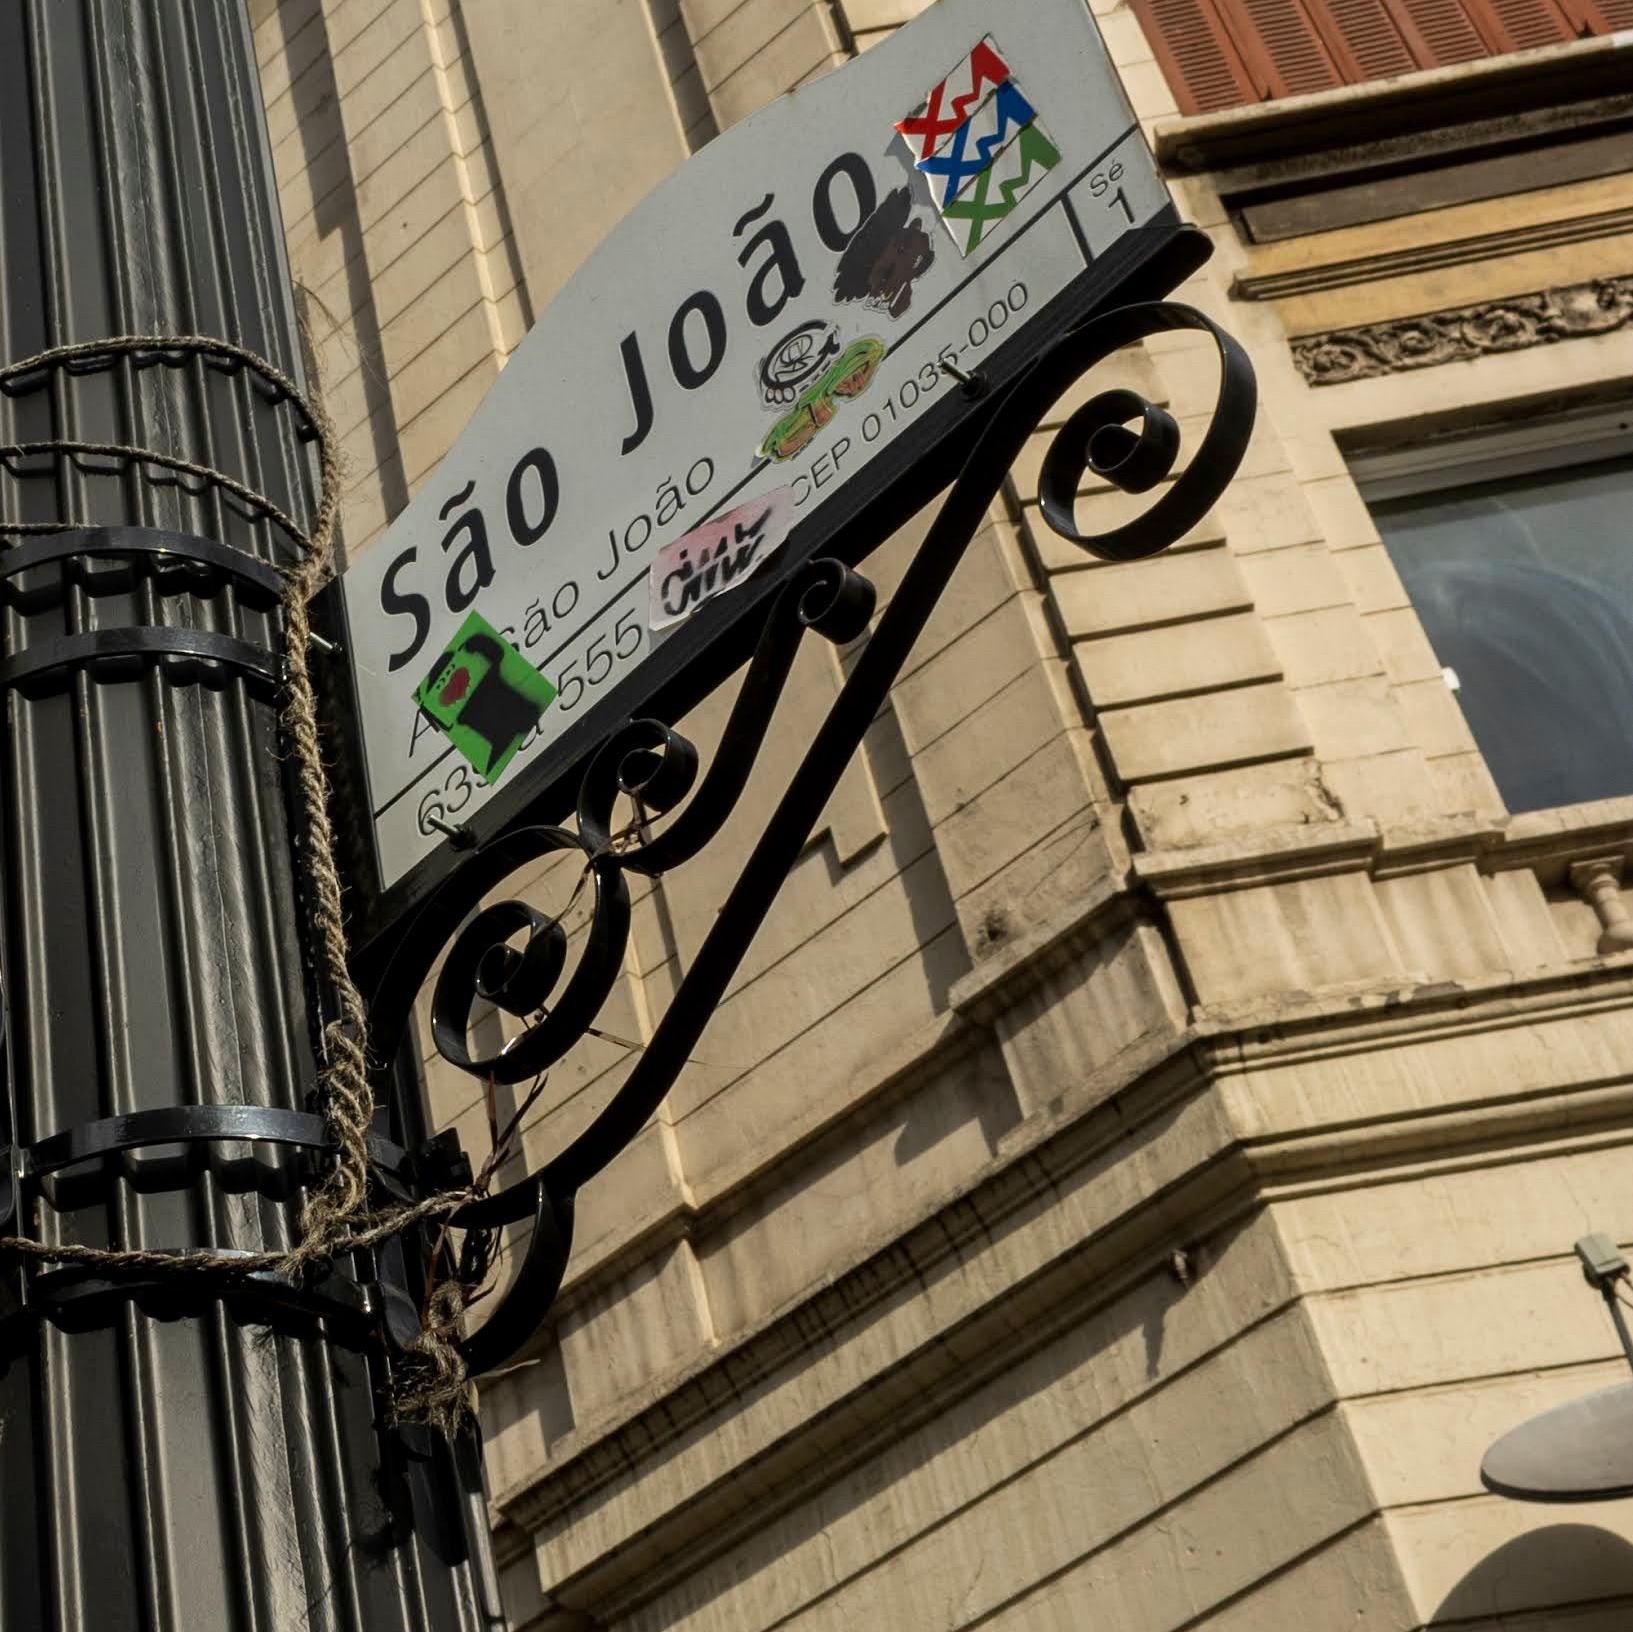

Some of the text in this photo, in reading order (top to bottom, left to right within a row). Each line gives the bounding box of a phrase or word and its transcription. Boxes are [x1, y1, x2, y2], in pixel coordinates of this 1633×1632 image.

[1089, 159, 1125, 199] Sé
[1107, 186, 1136, 225] 1
[379, 443, 561, 673] São
[619, 150, 878, 457] João
[555, 607, 644, 712] 555
[860, 281, 1030, 443] 01035-000
[596, 456, 715, 581] João
